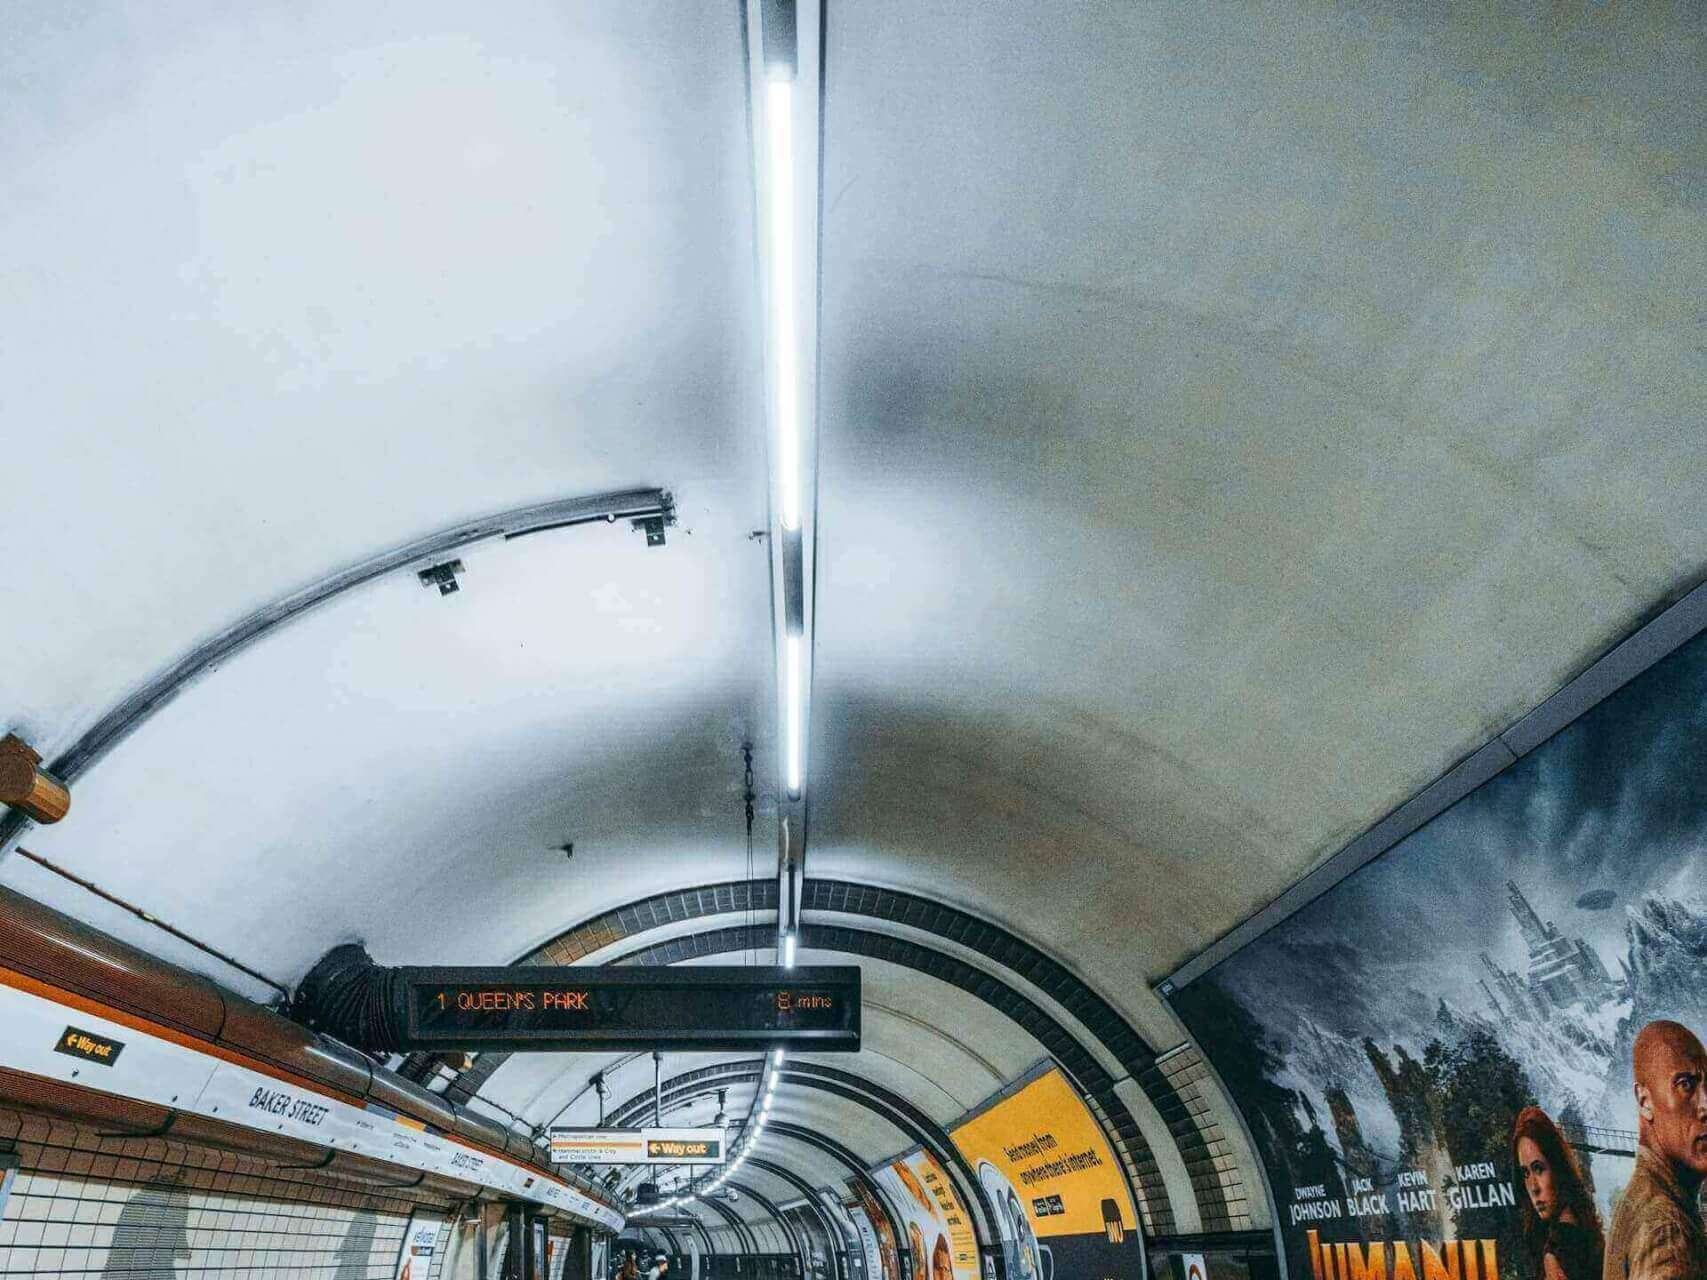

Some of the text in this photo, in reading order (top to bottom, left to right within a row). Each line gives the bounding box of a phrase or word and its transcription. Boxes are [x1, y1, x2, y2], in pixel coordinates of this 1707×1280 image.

[438, 993, 446, 1010] 1
[457, 992, 536, 1010] QUEEN'S
[543, 992, 590, 1010] PARK
[798, 996, 832, 1008] mins
[77, 1036, 97, 1055] Way
[249, 1087, 330, 1126] BAKER STREET
[661, 1142, 708, 1156] Way out
[1398, 1170, 1428, 1188] KEVIN
[1455, 1161, 1496, 1182] KAREN
[1295, 1183, 1326, 1200] DWAYNE
[1352, 1178, 1373, 1196] JACK
[1449, 1182, 1516, 1210] GILLAN
[1347, 1194, 1390, 1217] BLACK
[1398, 1189, 1437, 1214] HART
[1290, 1199, 1342, 1226] JOHNSON
